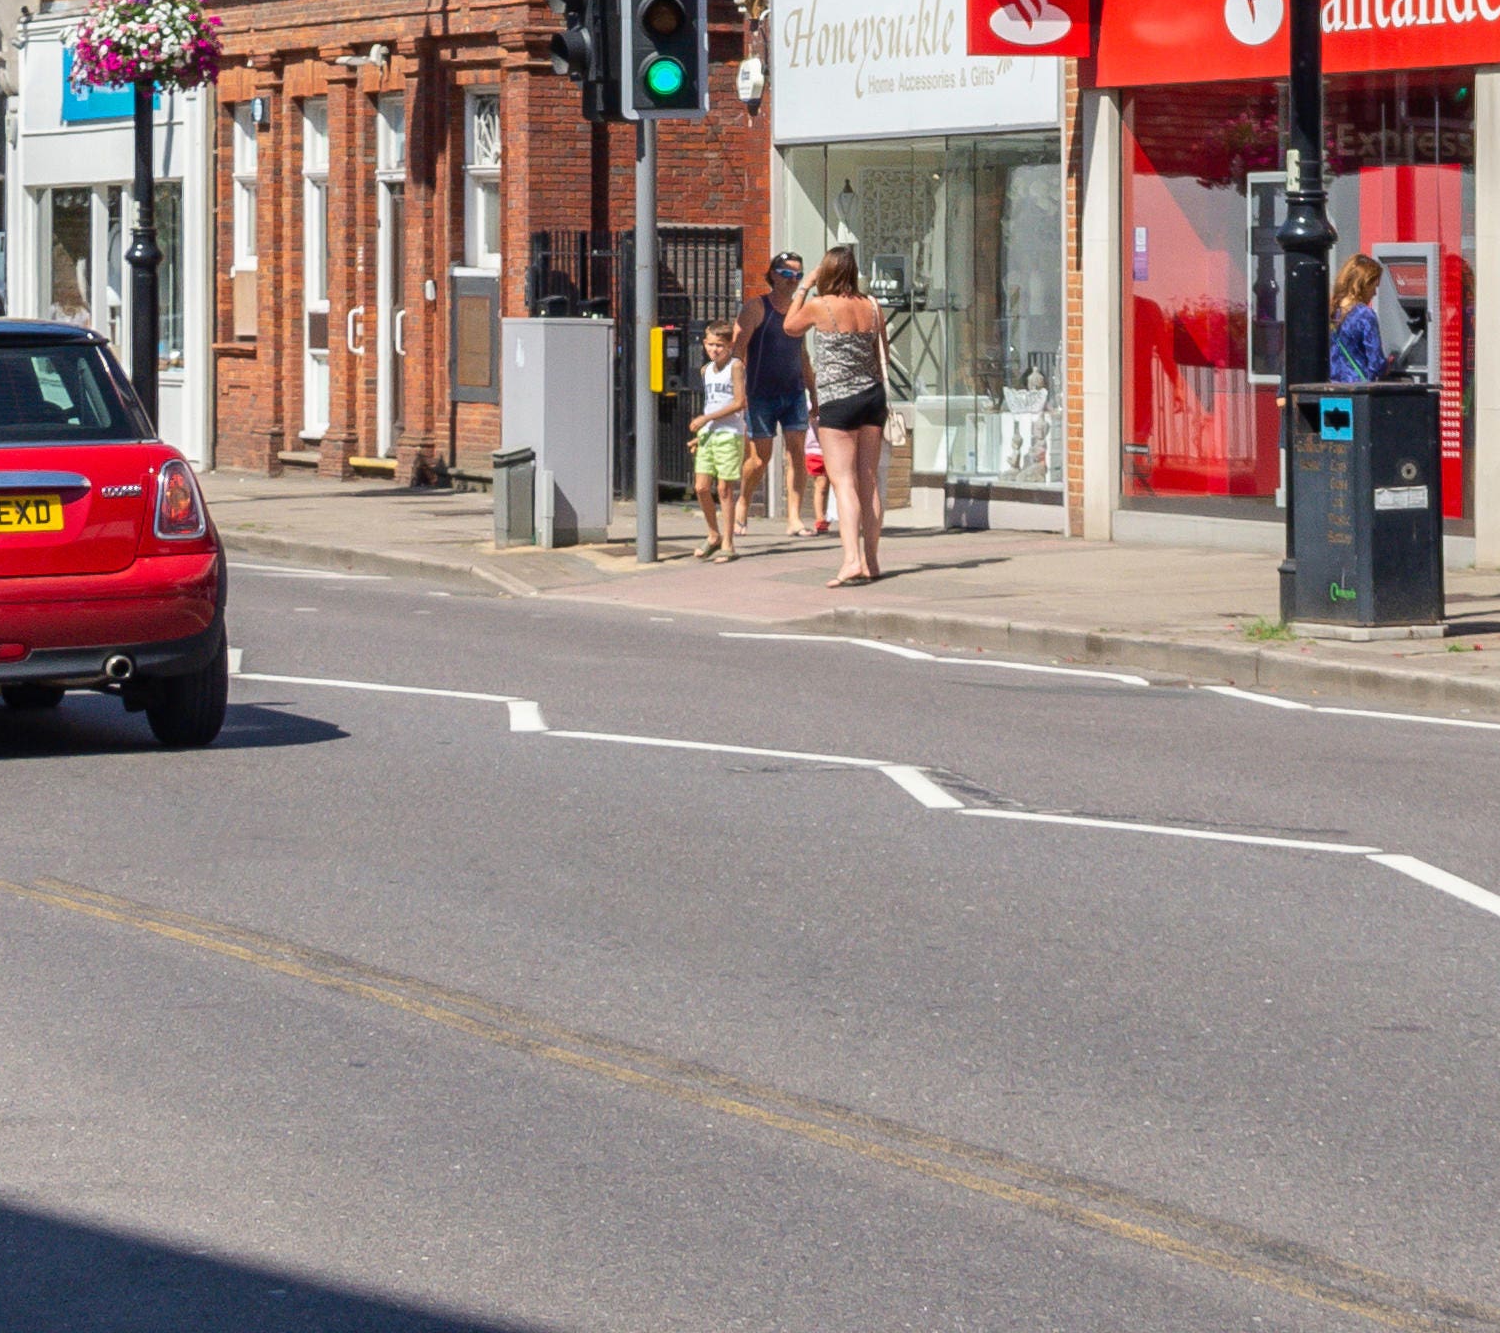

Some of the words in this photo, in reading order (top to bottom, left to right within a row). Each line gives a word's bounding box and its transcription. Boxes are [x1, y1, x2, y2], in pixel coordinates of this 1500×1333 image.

[867, 73, 895, 95] Home
[897, 69, 956, 92] Accessories
[959, 70, 967, 86] &
[971, 67, 995, 88] Gifts
